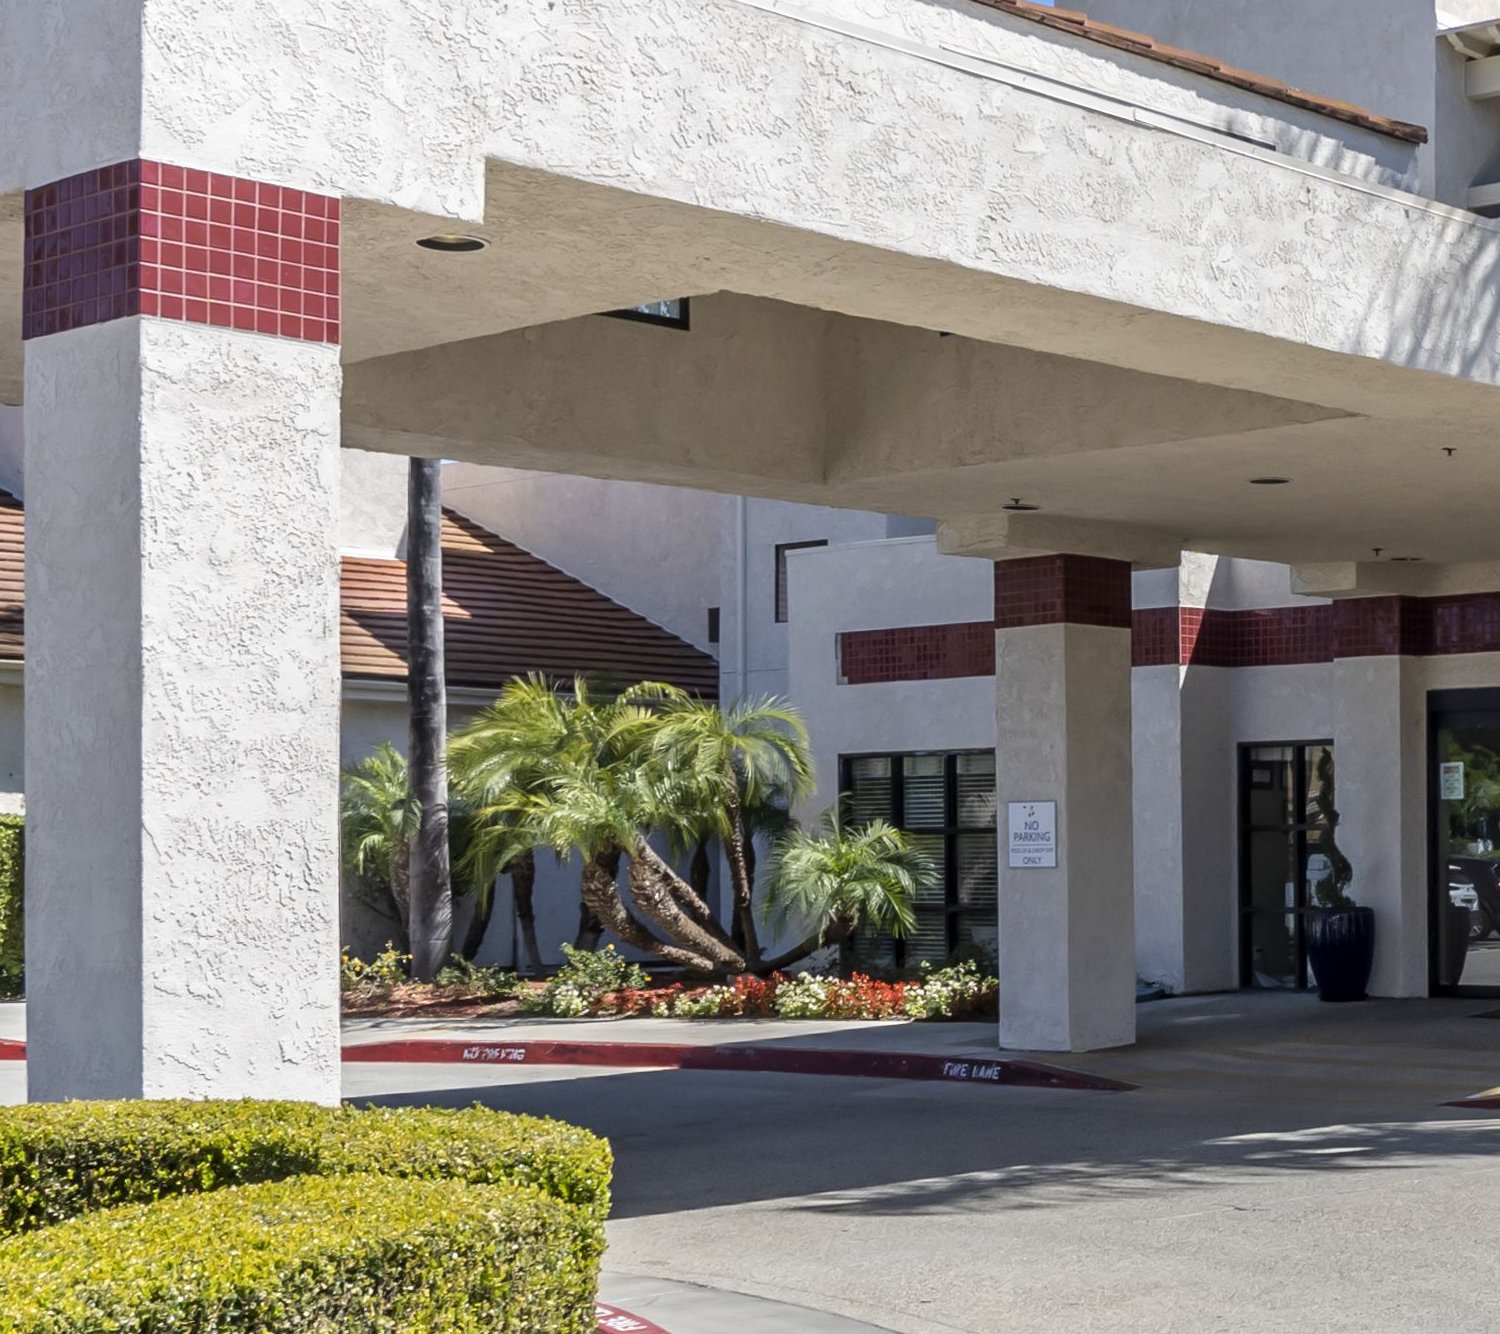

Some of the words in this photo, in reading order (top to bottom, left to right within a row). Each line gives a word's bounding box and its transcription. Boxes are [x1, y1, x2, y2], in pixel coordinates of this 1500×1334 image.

[1024, 820, 1039, 831] NO
[1013, 831, 1051, 842] PARKING
[1022, 856, 1042, 865] ONLY
[972, 1064, 1002, 1080] LANE
